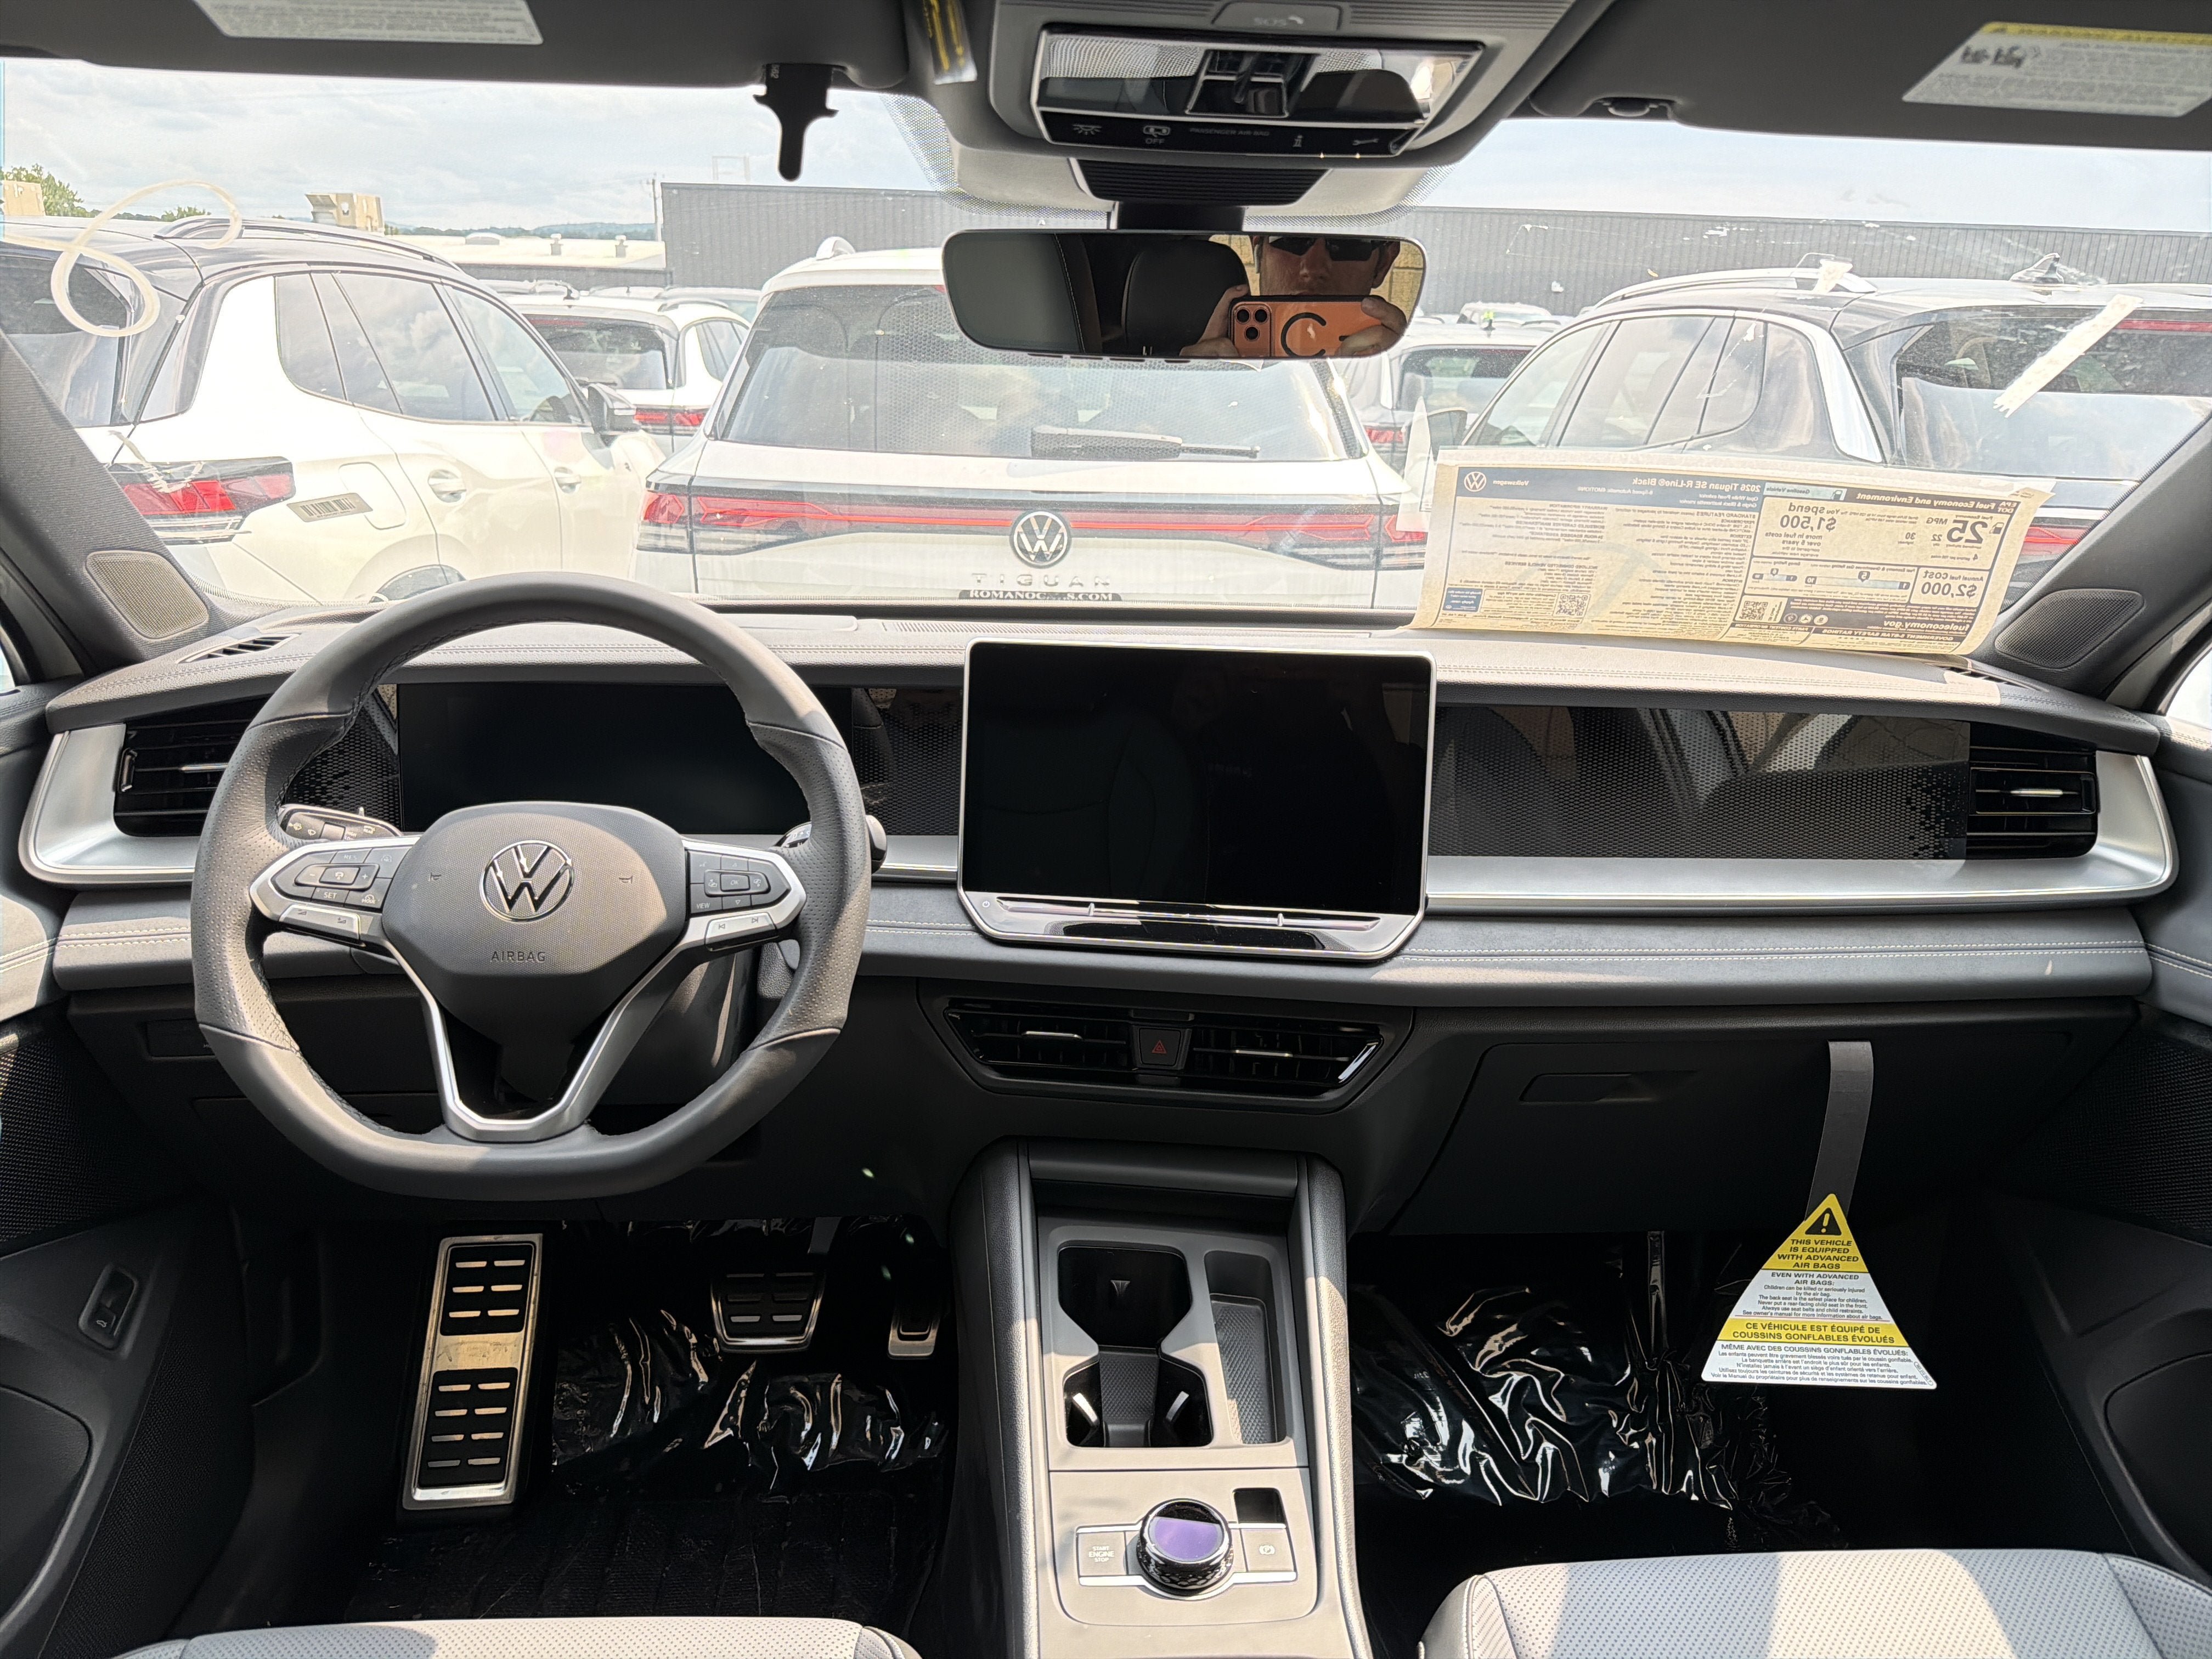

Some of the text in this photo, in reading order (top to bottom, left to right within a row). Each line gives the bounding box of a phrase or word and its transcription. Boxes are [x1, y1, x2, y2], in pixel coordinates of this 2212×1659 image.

[972, 573, 1110, 588] TIGUAN
[491, 951, 546, 962] AIRBAG
[1761, 1322, 1807, 1331] VÉHICULE
[1831, 1324, 1865, 1333] ÉQUIPÉ
[1733, 1331, 1894, 1343] COUSSINS GONFLABLES ÉVOLUÉS
